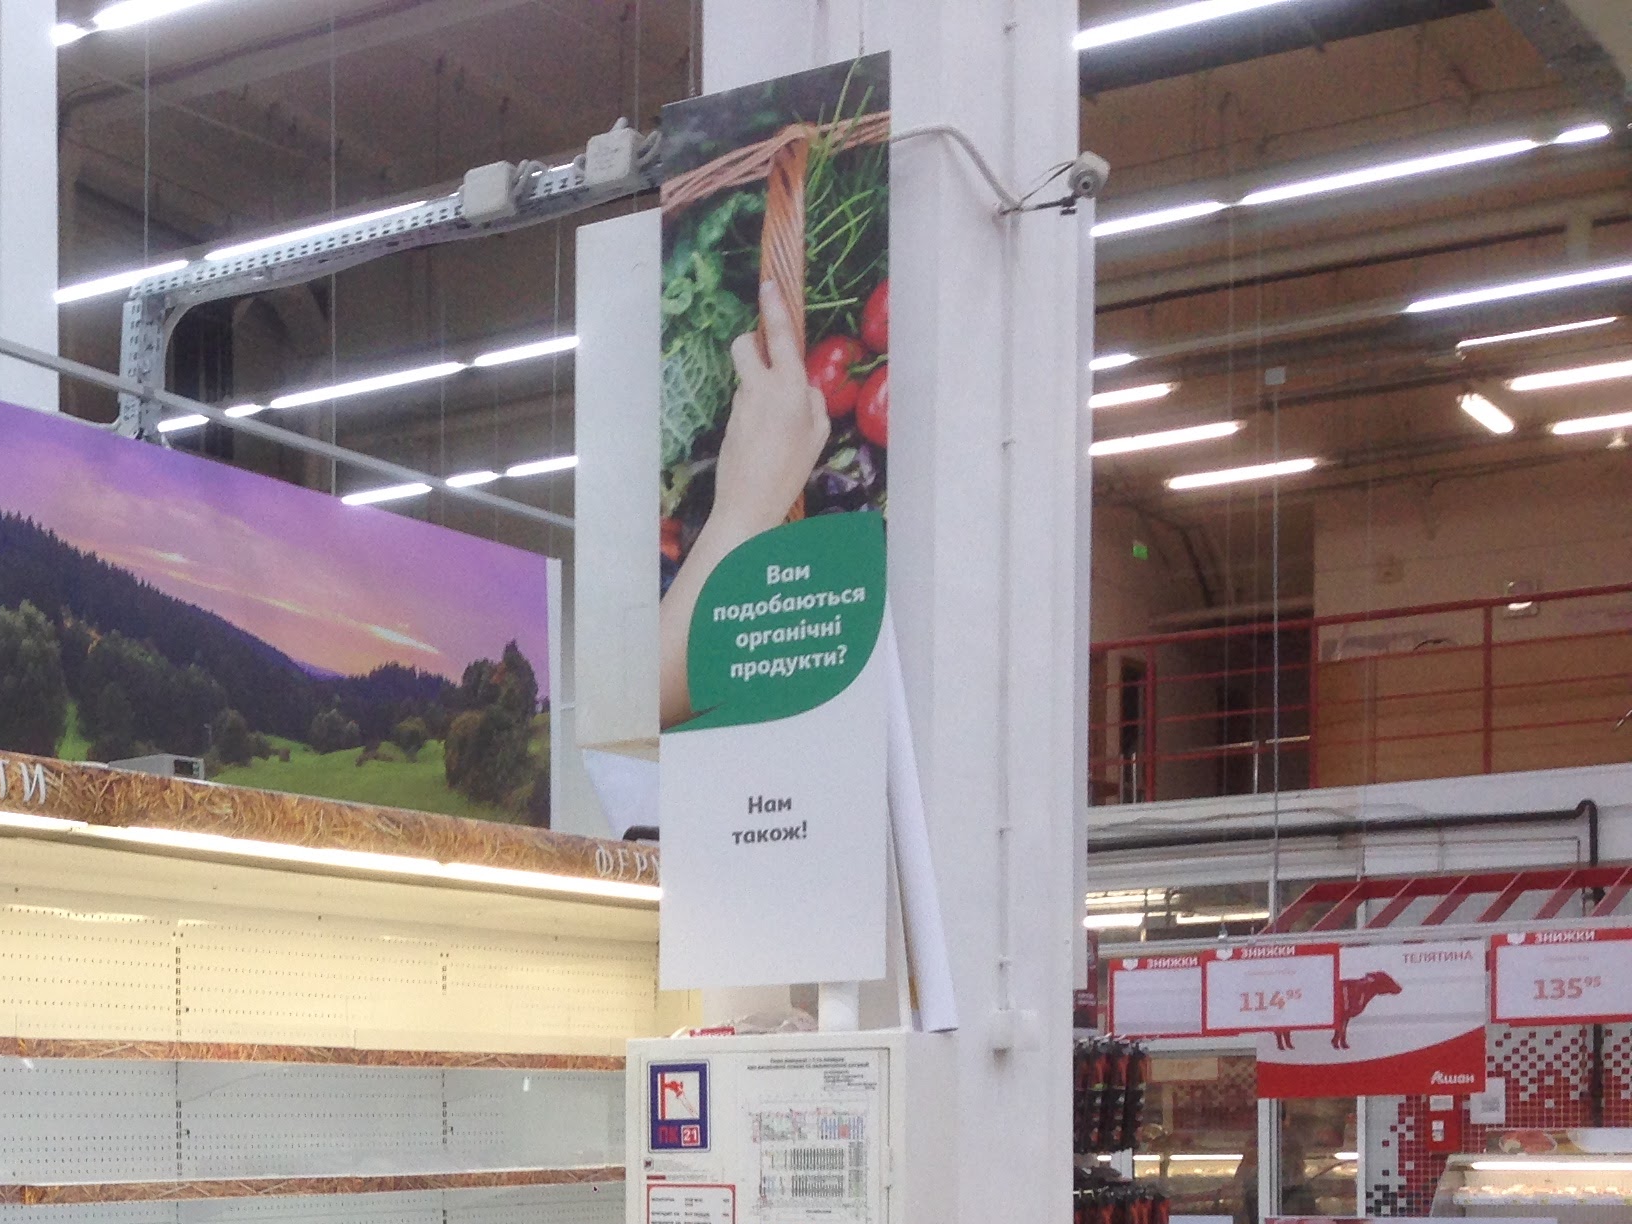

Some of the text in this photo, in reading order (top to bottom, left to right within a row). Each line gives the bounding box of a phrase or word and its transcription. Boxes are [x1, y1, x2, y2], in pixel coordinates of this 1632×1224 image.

[767, 564, 810, 585] Вам
[713, 586, 866, 622] подобаються
[735, 614, 842, 651] органічні
[730, 645, 848, 682] продукти?
[748, 796, 792, 814] Нам
[732, 821, 808, 845] також!
[1535, 930, 1596, 943] ЗНИЖКИ
[1241, 946, 1296, 959] ЗНИЖКИ
[1402, 950, 1473, 964] ТЕЛЯТИНА
[1147, 957, 1198, 969] ЗНИЖКИ
[683, 1129, 698, 1141] 21
